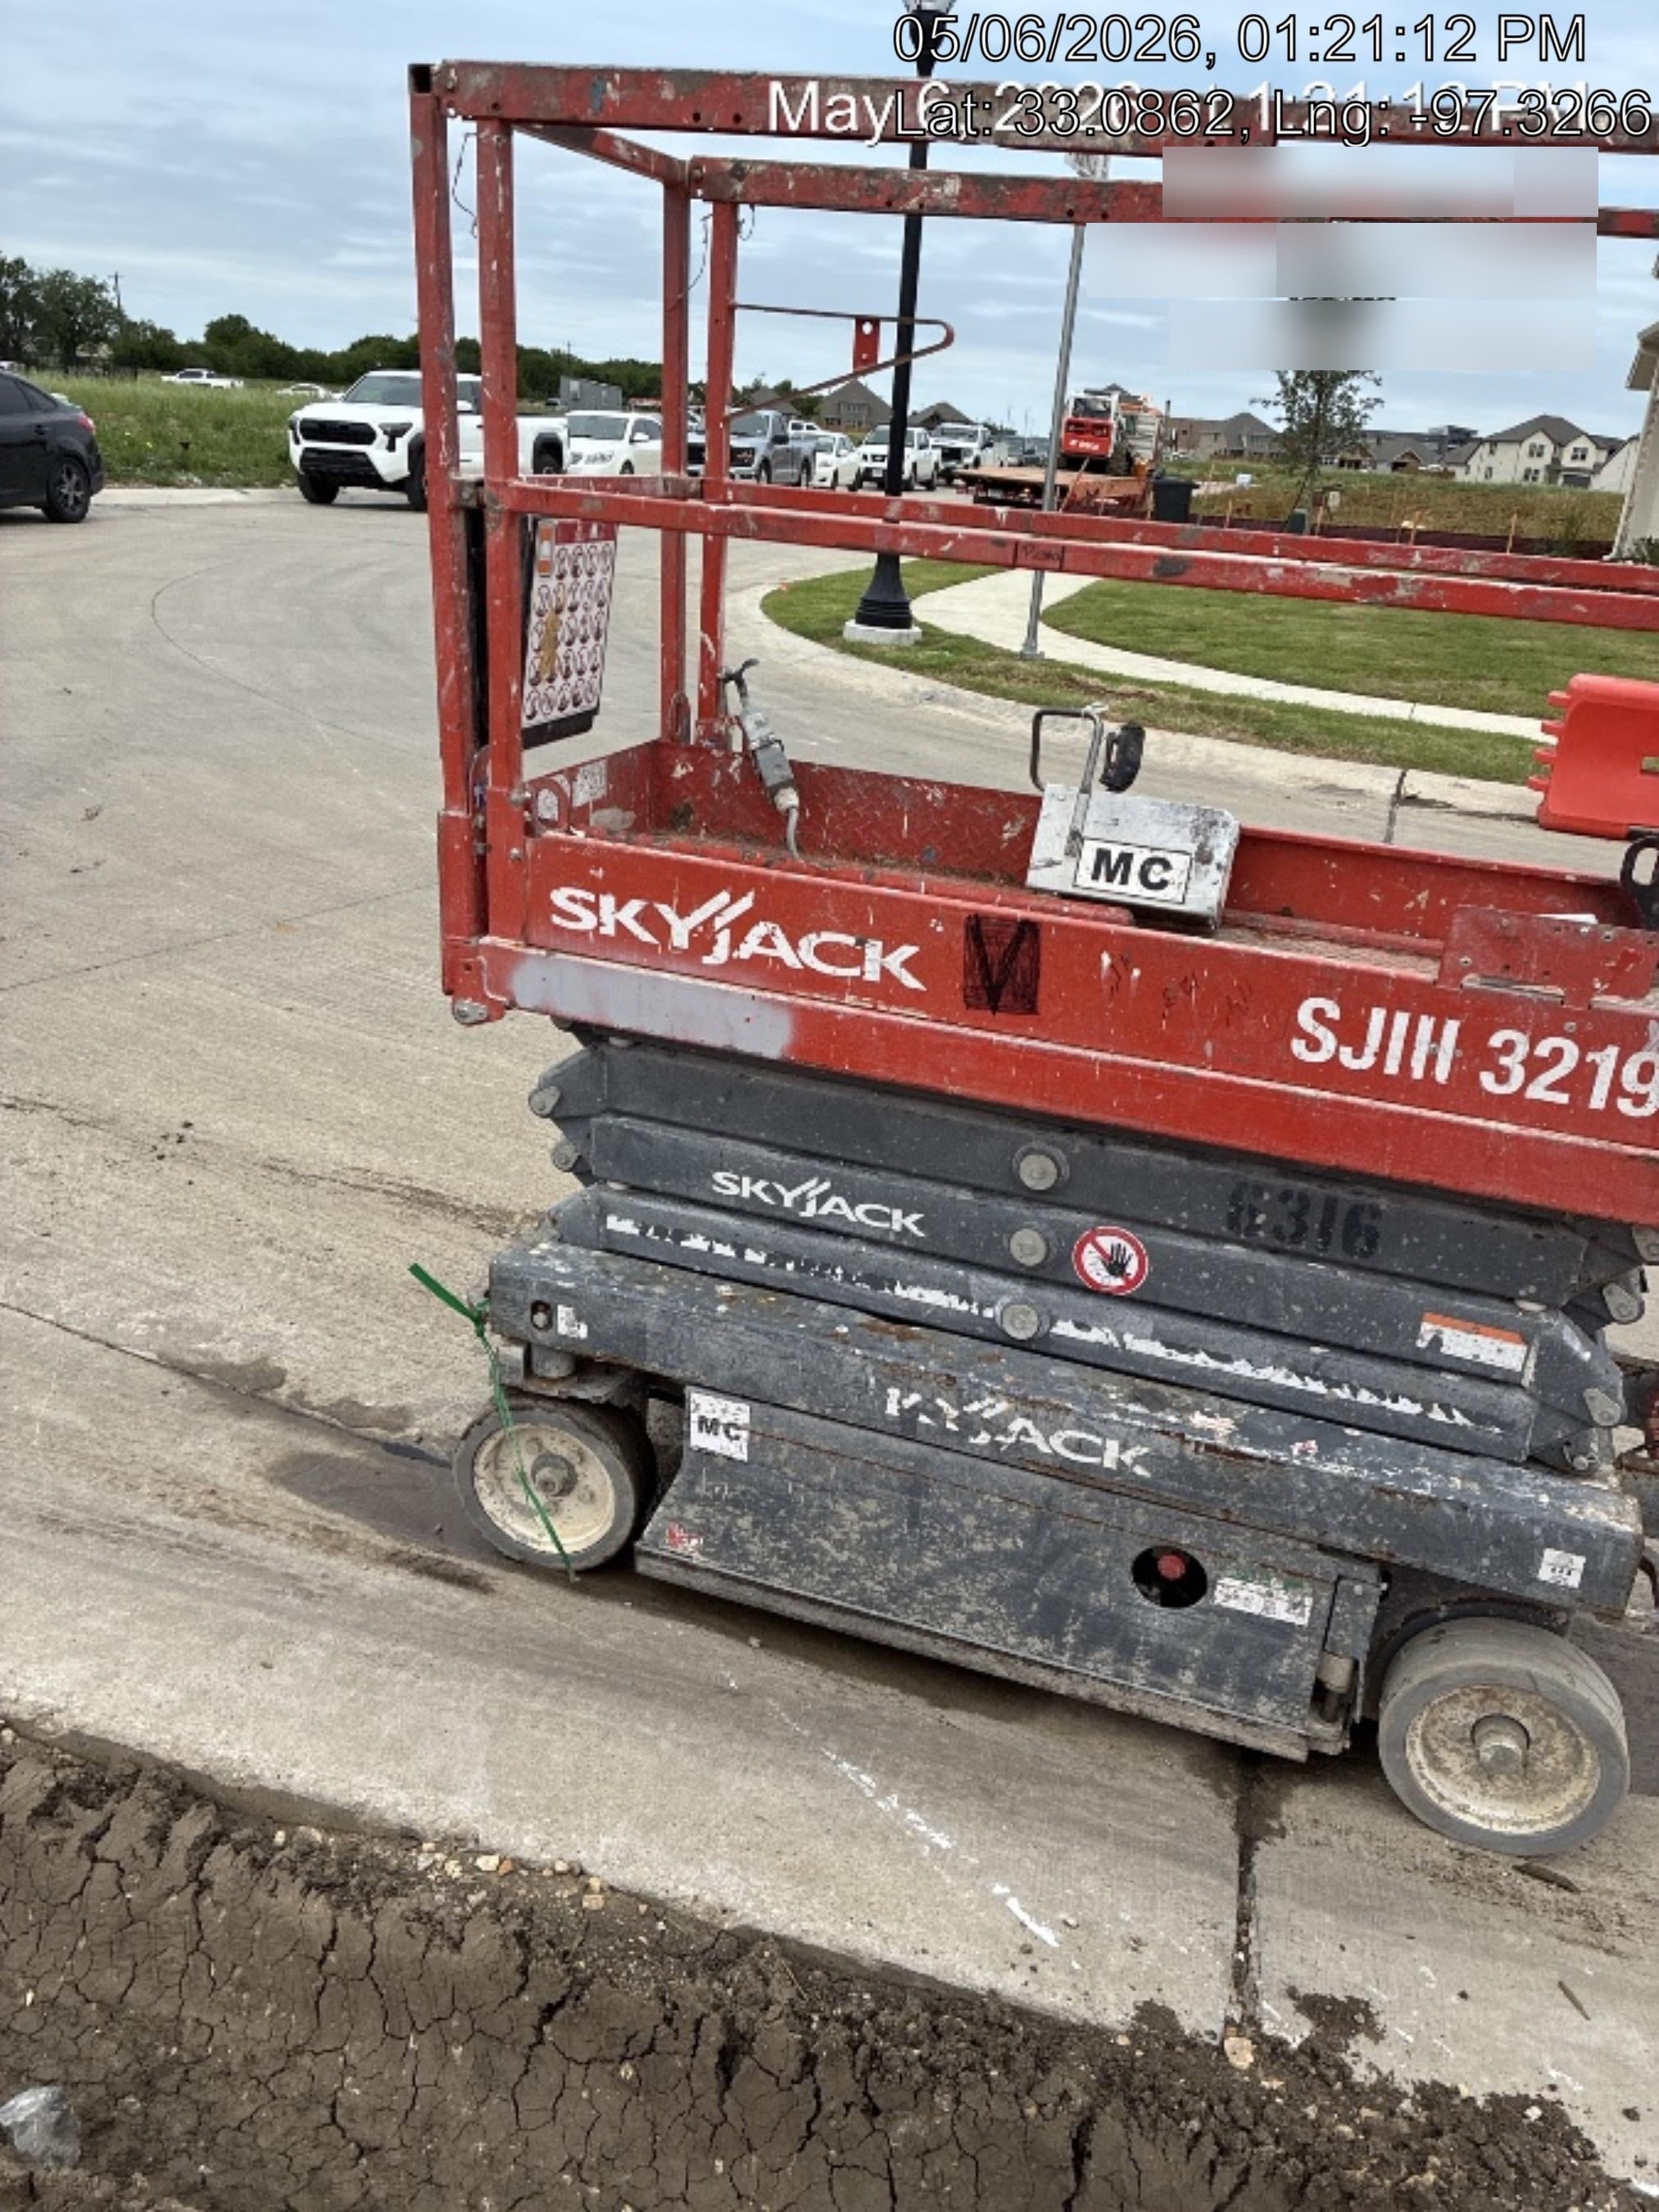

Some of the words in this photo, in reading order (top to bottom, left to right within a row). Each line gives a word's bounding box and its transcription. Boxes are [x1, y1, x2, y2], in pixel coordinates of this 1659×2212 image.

[1090, 847, 1173, 891] MC
[550, 886, 927, 991] SKYJACK
[1479, 1029, 1659, 1117] 3219
[712, 1171, 926, 1237] SKYJACK
[697, 1414, 741, 1442] MC
